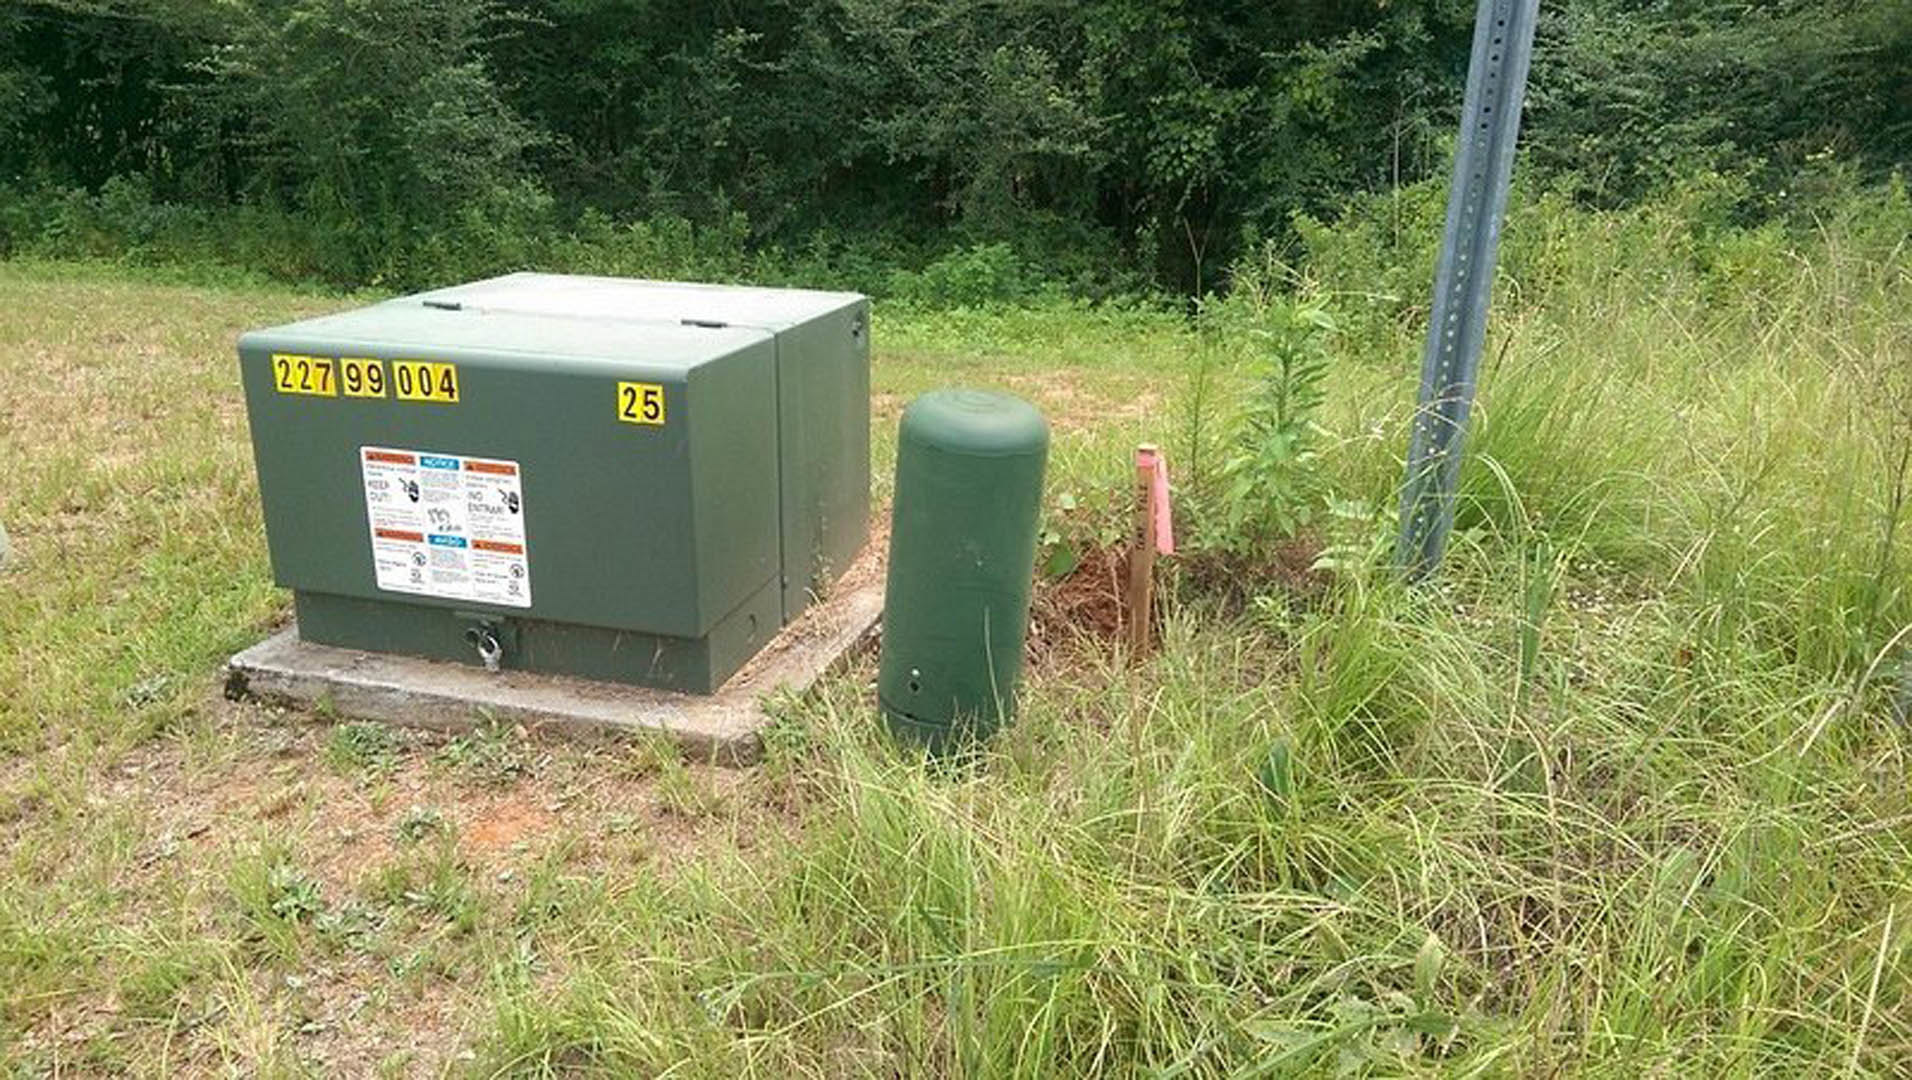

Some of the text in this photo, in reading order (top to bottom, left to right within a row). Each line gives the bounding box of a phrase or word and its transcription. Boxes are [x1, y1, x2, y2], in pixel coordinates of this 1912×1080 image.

[278, 358, 455, 399] 227 99 004
[623, 386, 660, 420] 25
